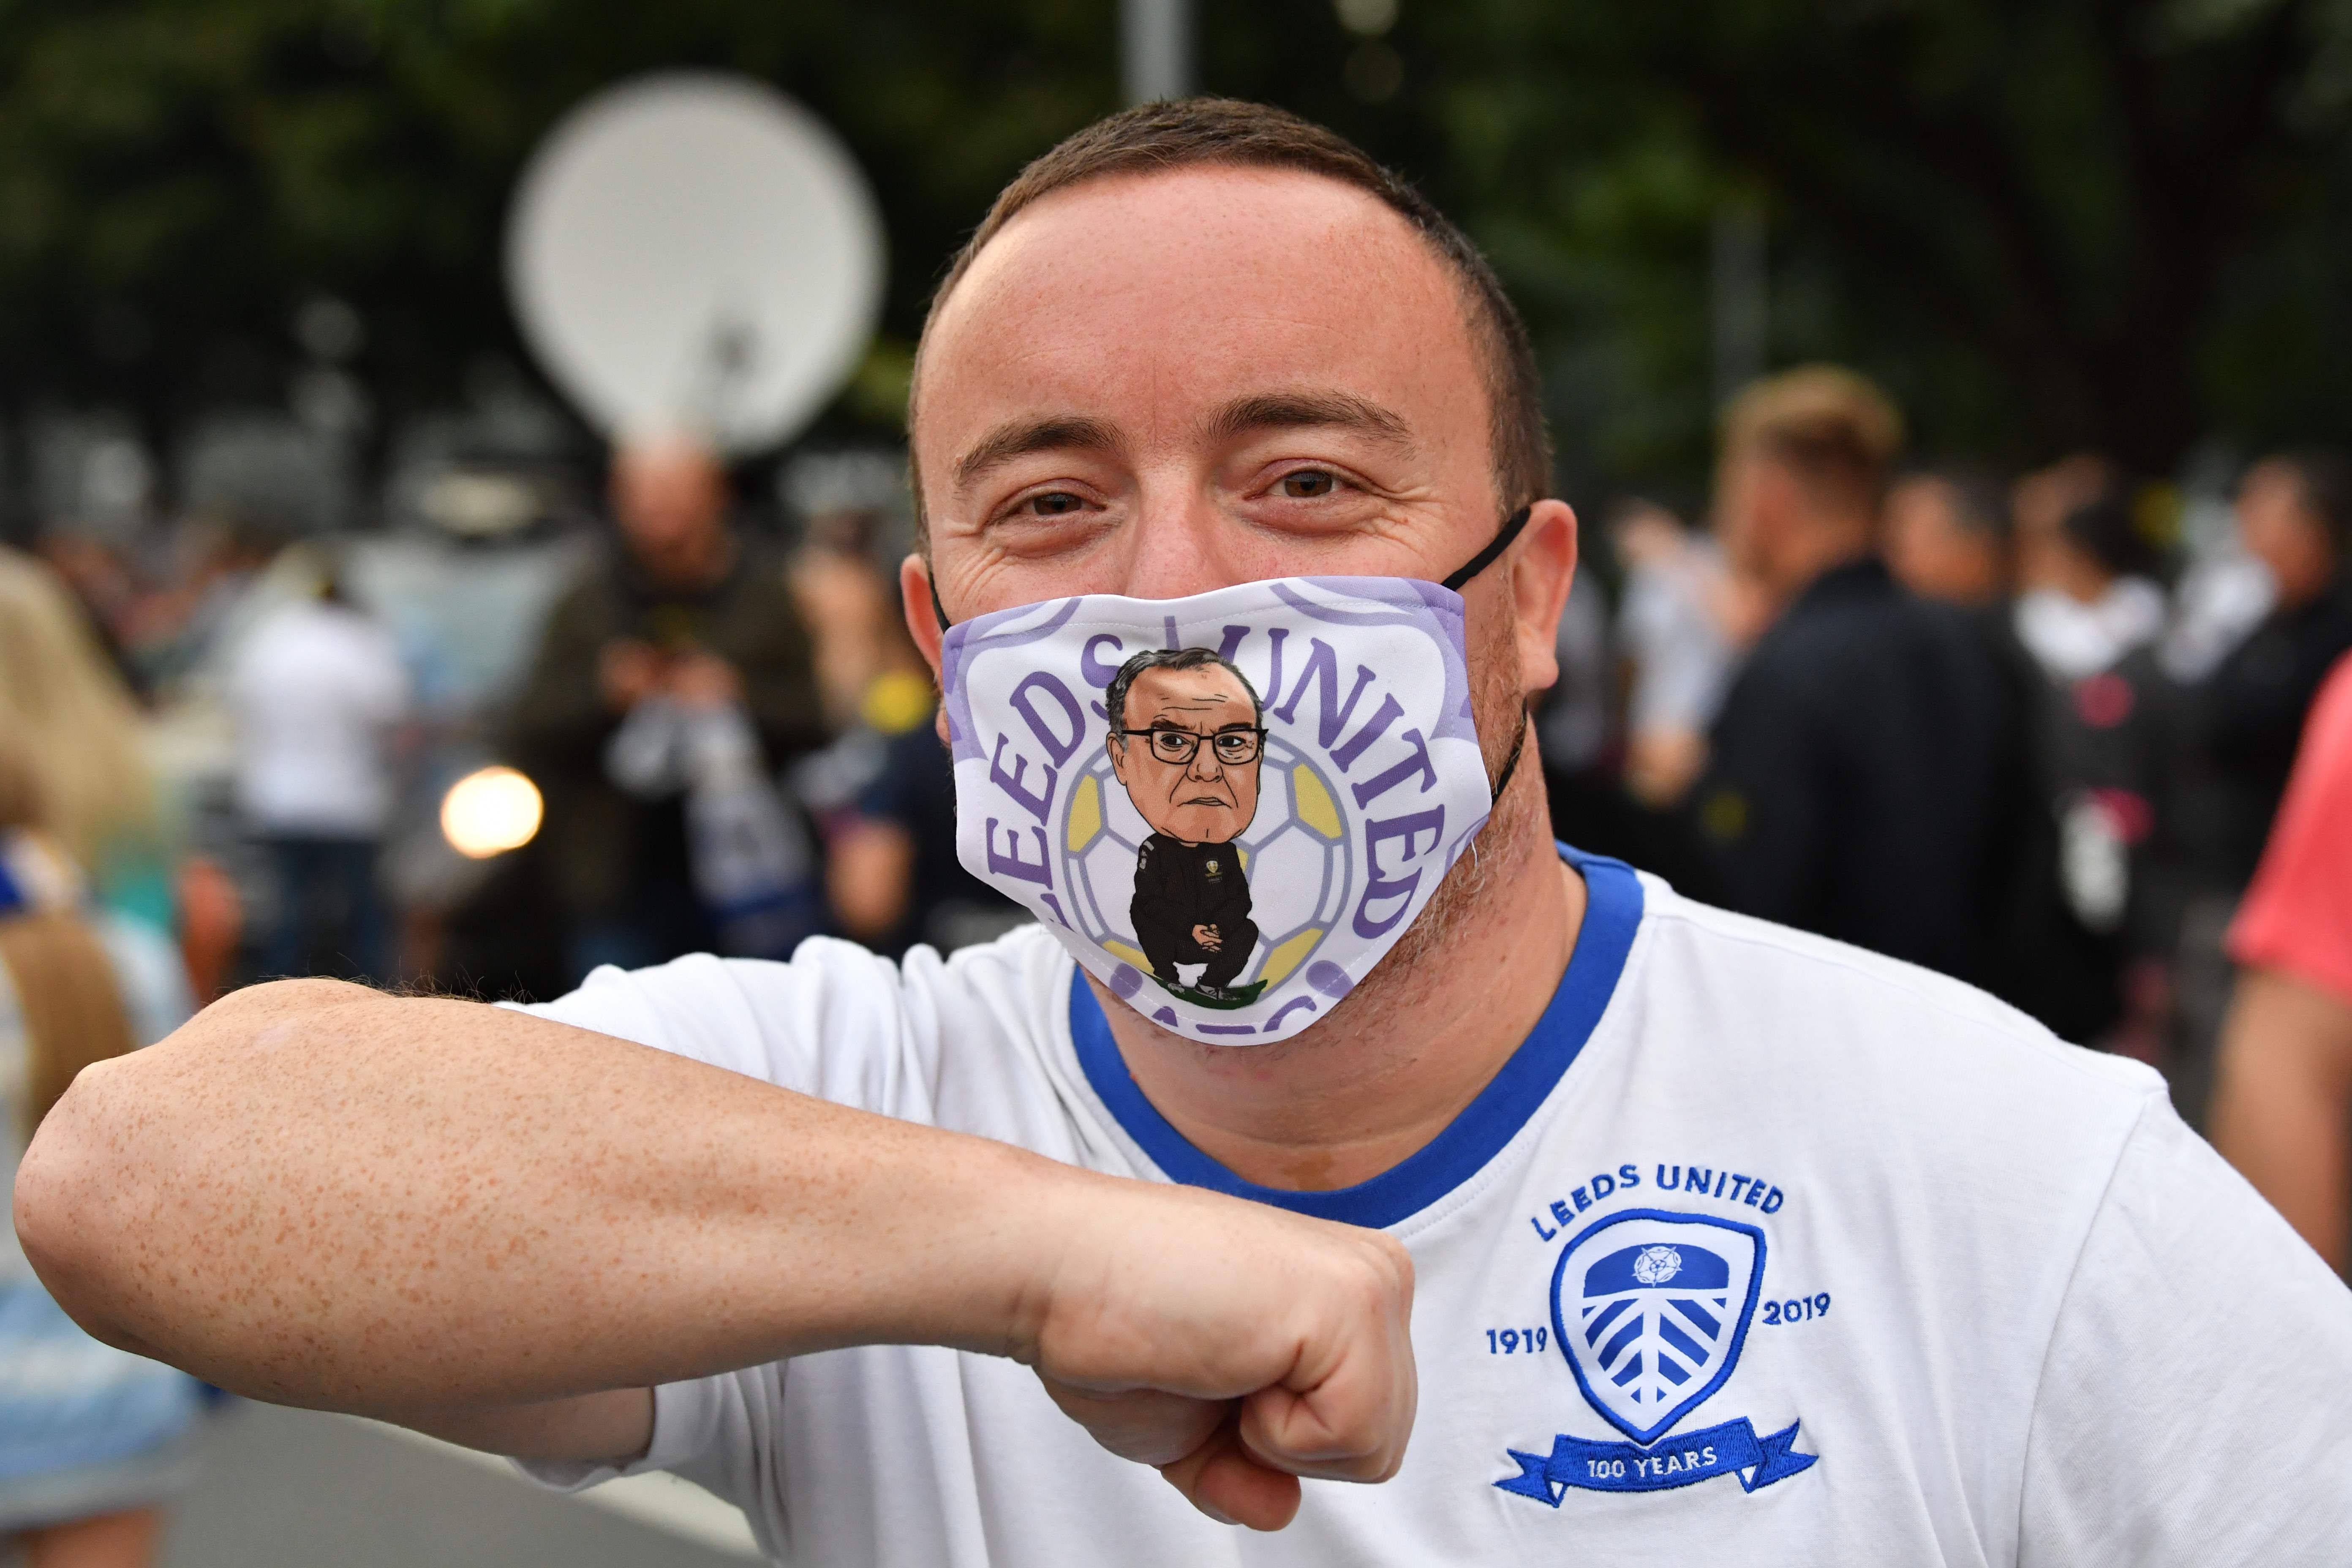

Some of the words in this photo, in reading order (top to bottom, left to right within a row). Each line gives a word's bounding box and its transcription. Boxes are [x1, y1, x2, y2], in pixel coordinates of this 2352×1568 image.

[1217, 625, 1445, 939] UNITED
[1531, 1165, 1640, 1241] LEEDS
[1656, 1164, 1784, 1215] UNITED
[1762, 1293, 1831, 1325] 2019
[1486, 1327, 1548, 1354] 1919
[1587, 1459, 1626, 1478] 100
[1633, 1447, 1718, 1478] YEARS
